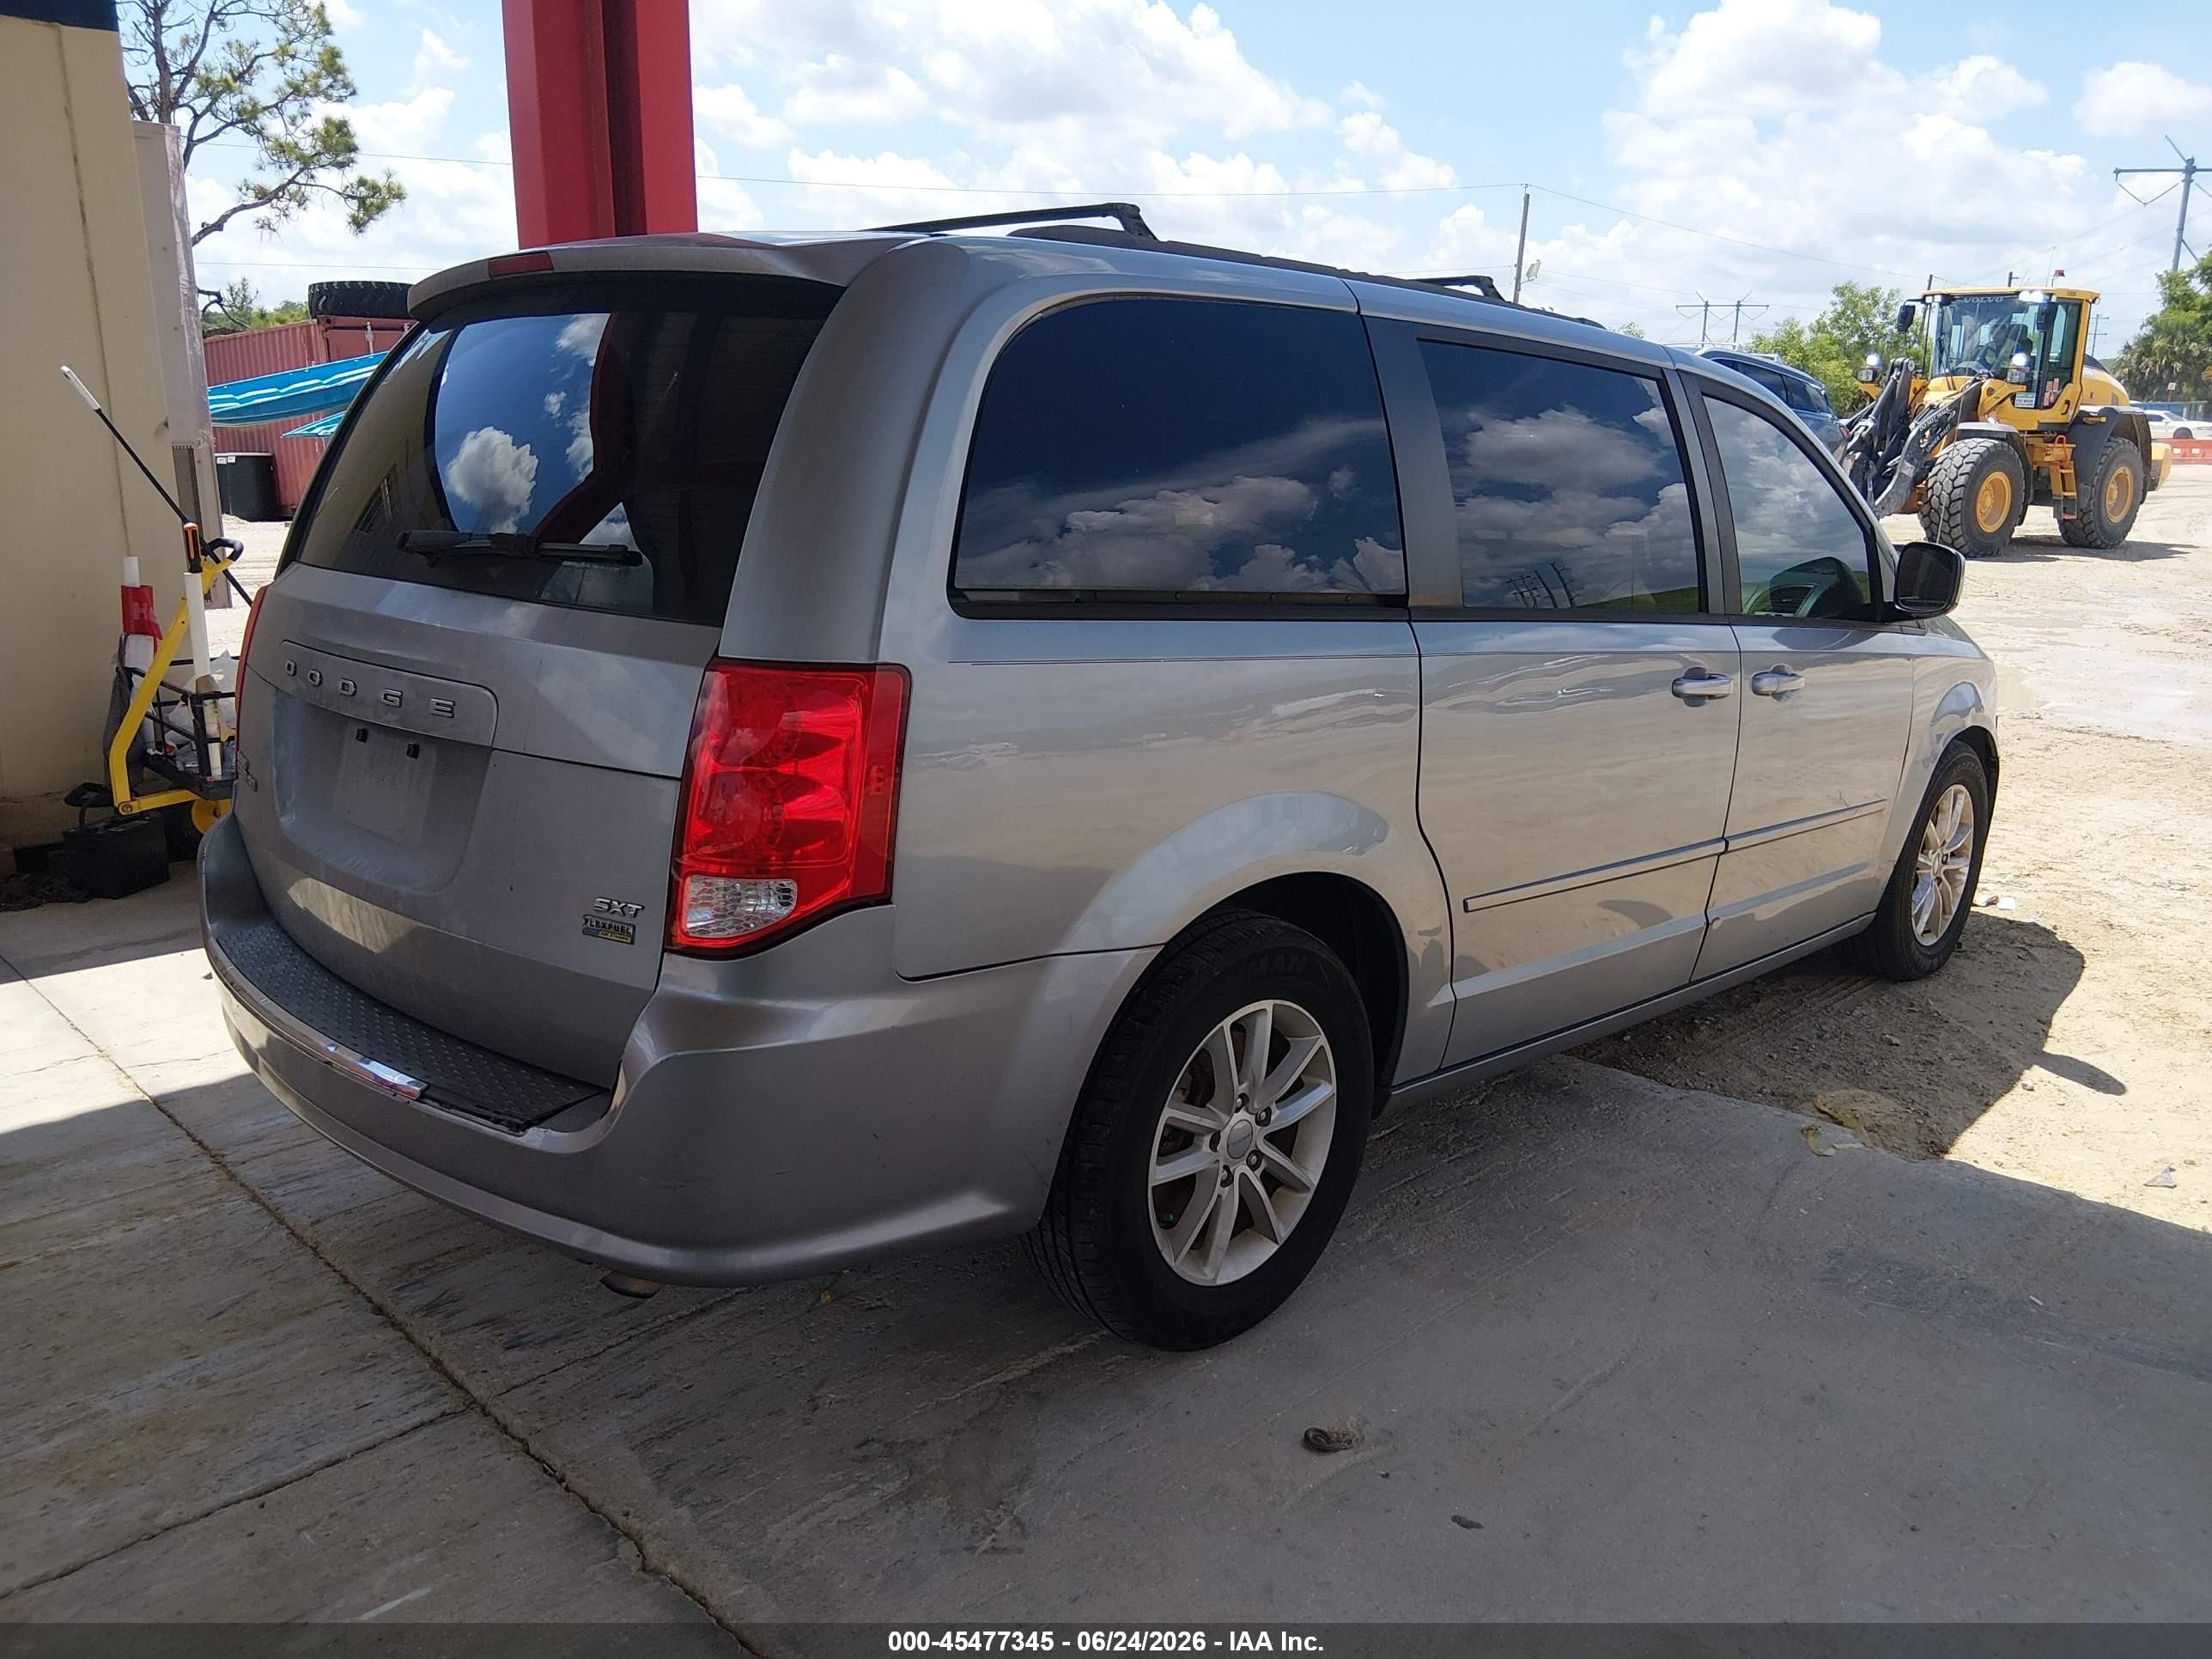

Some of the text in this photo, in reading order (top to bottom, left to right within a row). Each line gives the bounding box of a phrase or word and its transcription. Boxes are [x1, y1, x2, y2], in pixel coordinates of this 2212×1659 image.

[284, 659, 457, 719] DODGE
[593, 896, 645, 918] SXT
[584, 918, 632, 935] FLEXFUEL
